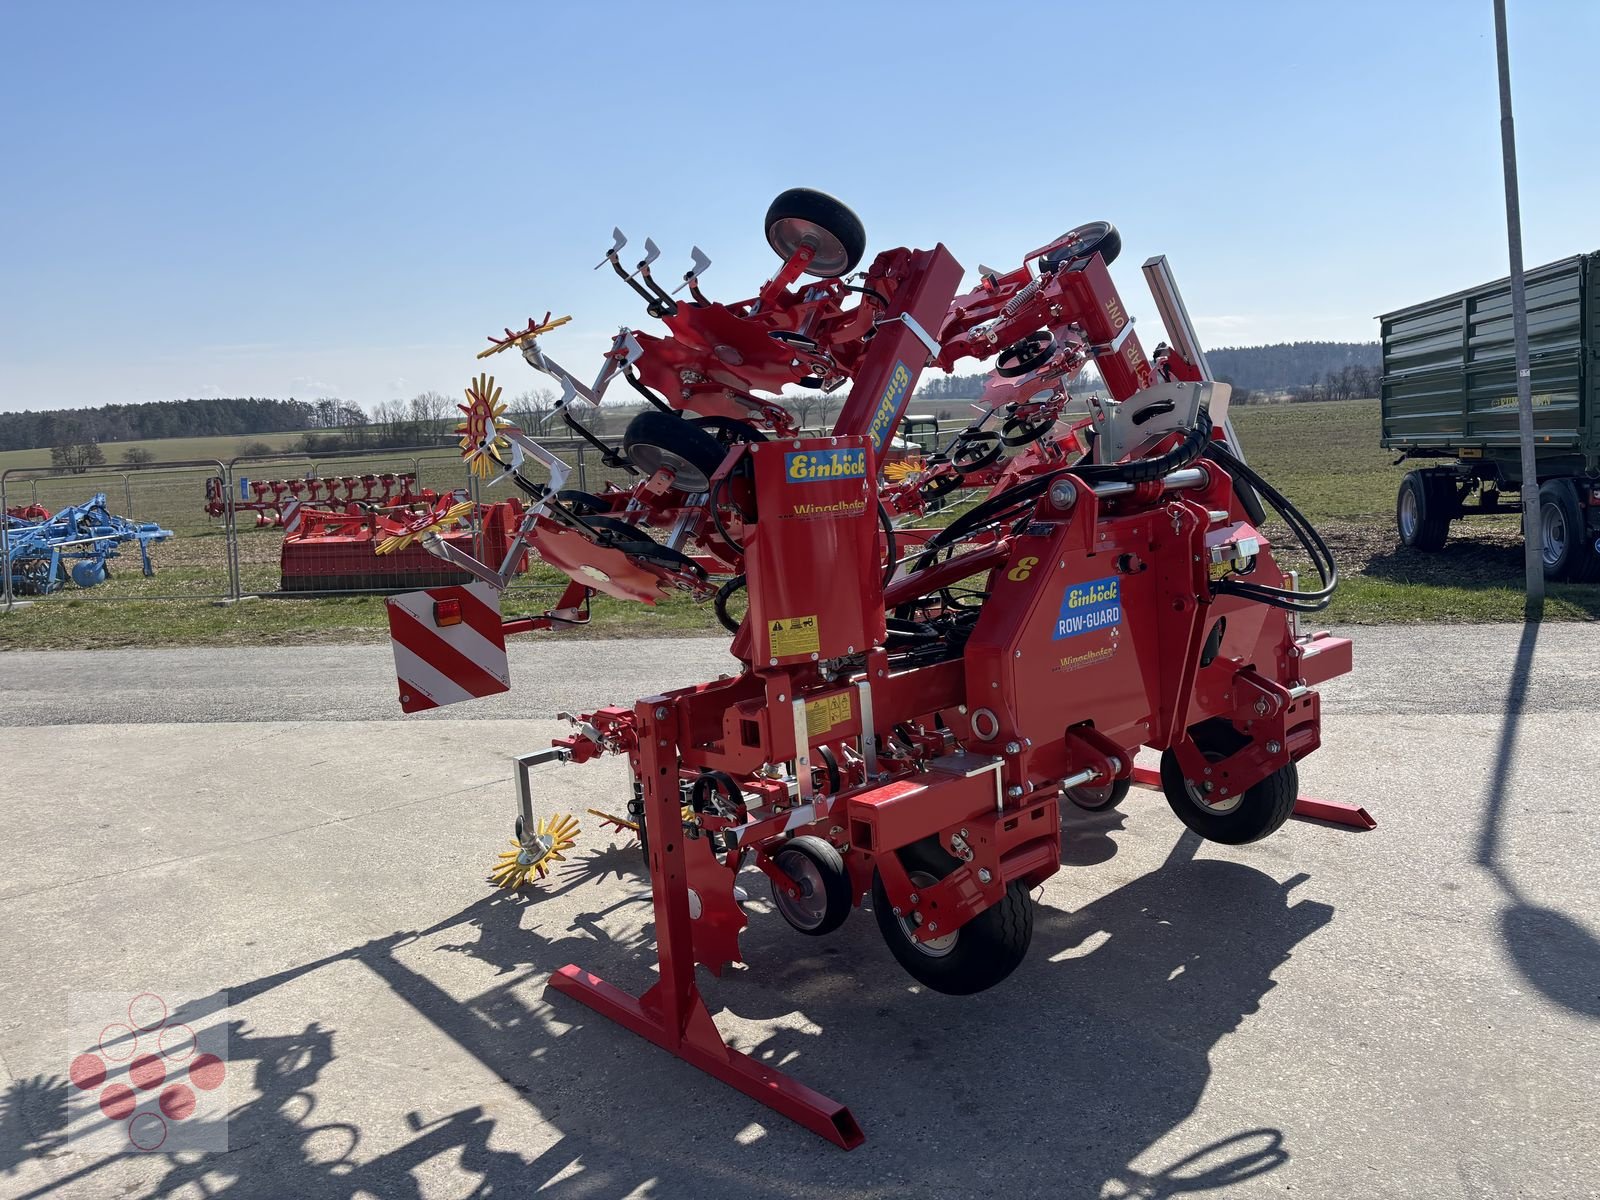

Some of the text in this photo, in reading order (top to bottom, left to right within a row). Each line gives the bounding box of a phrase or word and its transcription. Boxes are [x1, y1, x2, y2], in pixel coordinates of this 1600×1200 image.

[1105, 297, 1125, 328] ONE
[869, 365, 909, 448] Einböck
[789, 452, 865, 479] Einböck
[1068, 581, 1117, 609] Einböck
[1059, 607, 1119, 635] ROW-GUARD
